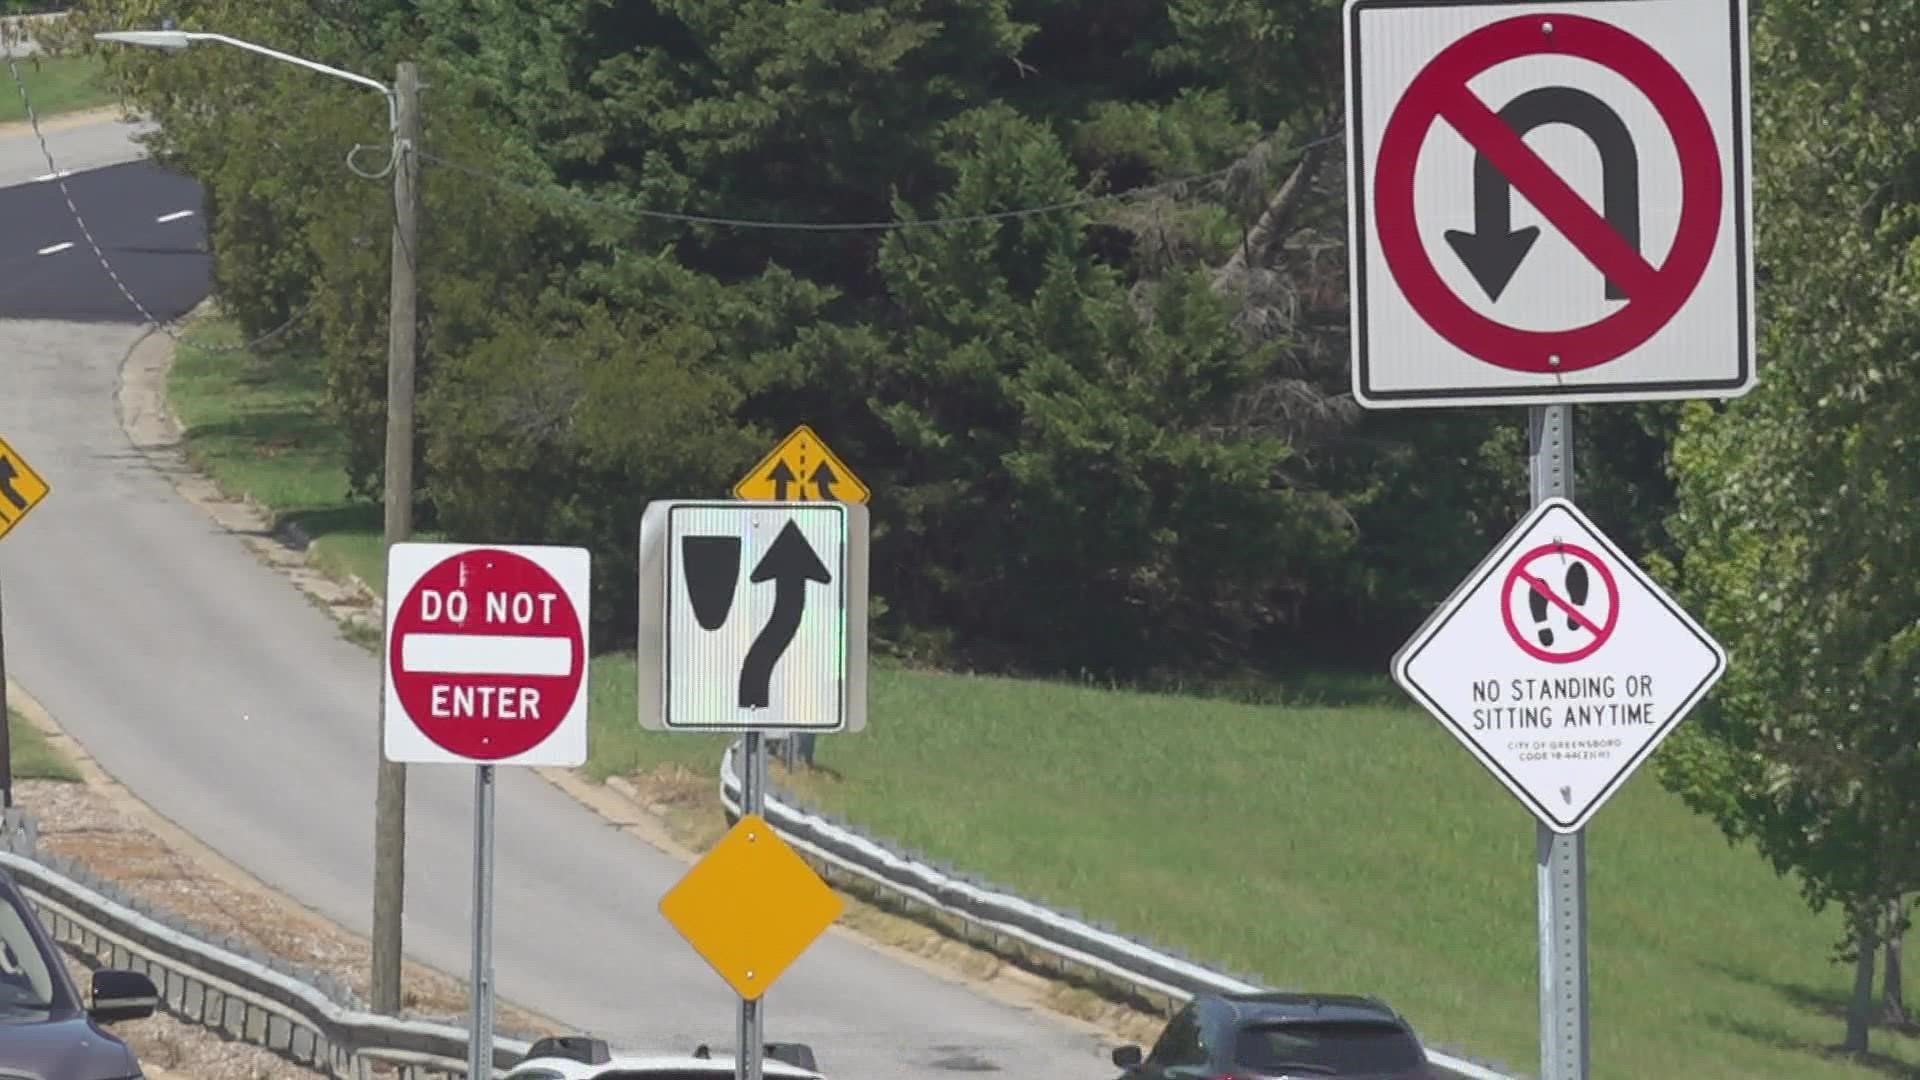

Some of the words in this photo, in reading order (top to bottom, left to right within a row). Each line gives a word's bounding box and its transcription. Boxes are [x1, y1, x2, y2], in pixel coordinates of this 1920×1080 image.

[421, 590, 468, 622] DO
[486, 592, 557, 624] NOT
[1473, 679, 1500, 702] NO
[1511, 676, 1616, 701] STANDING
[1625, 675, 1653, 697] OR
[431, 685, 540, 720] ENTER
[1473, 706, 1552, 730] SITTING
[1564, 703, 1656, 728] ANYTIME
[1507, 741, 1529, 750] CITY
[1533, 740, 1546, 750] OF
[1550, 738, 1622, 749] GREENSBORO
[1519, 752, 1548, 761] CODE
